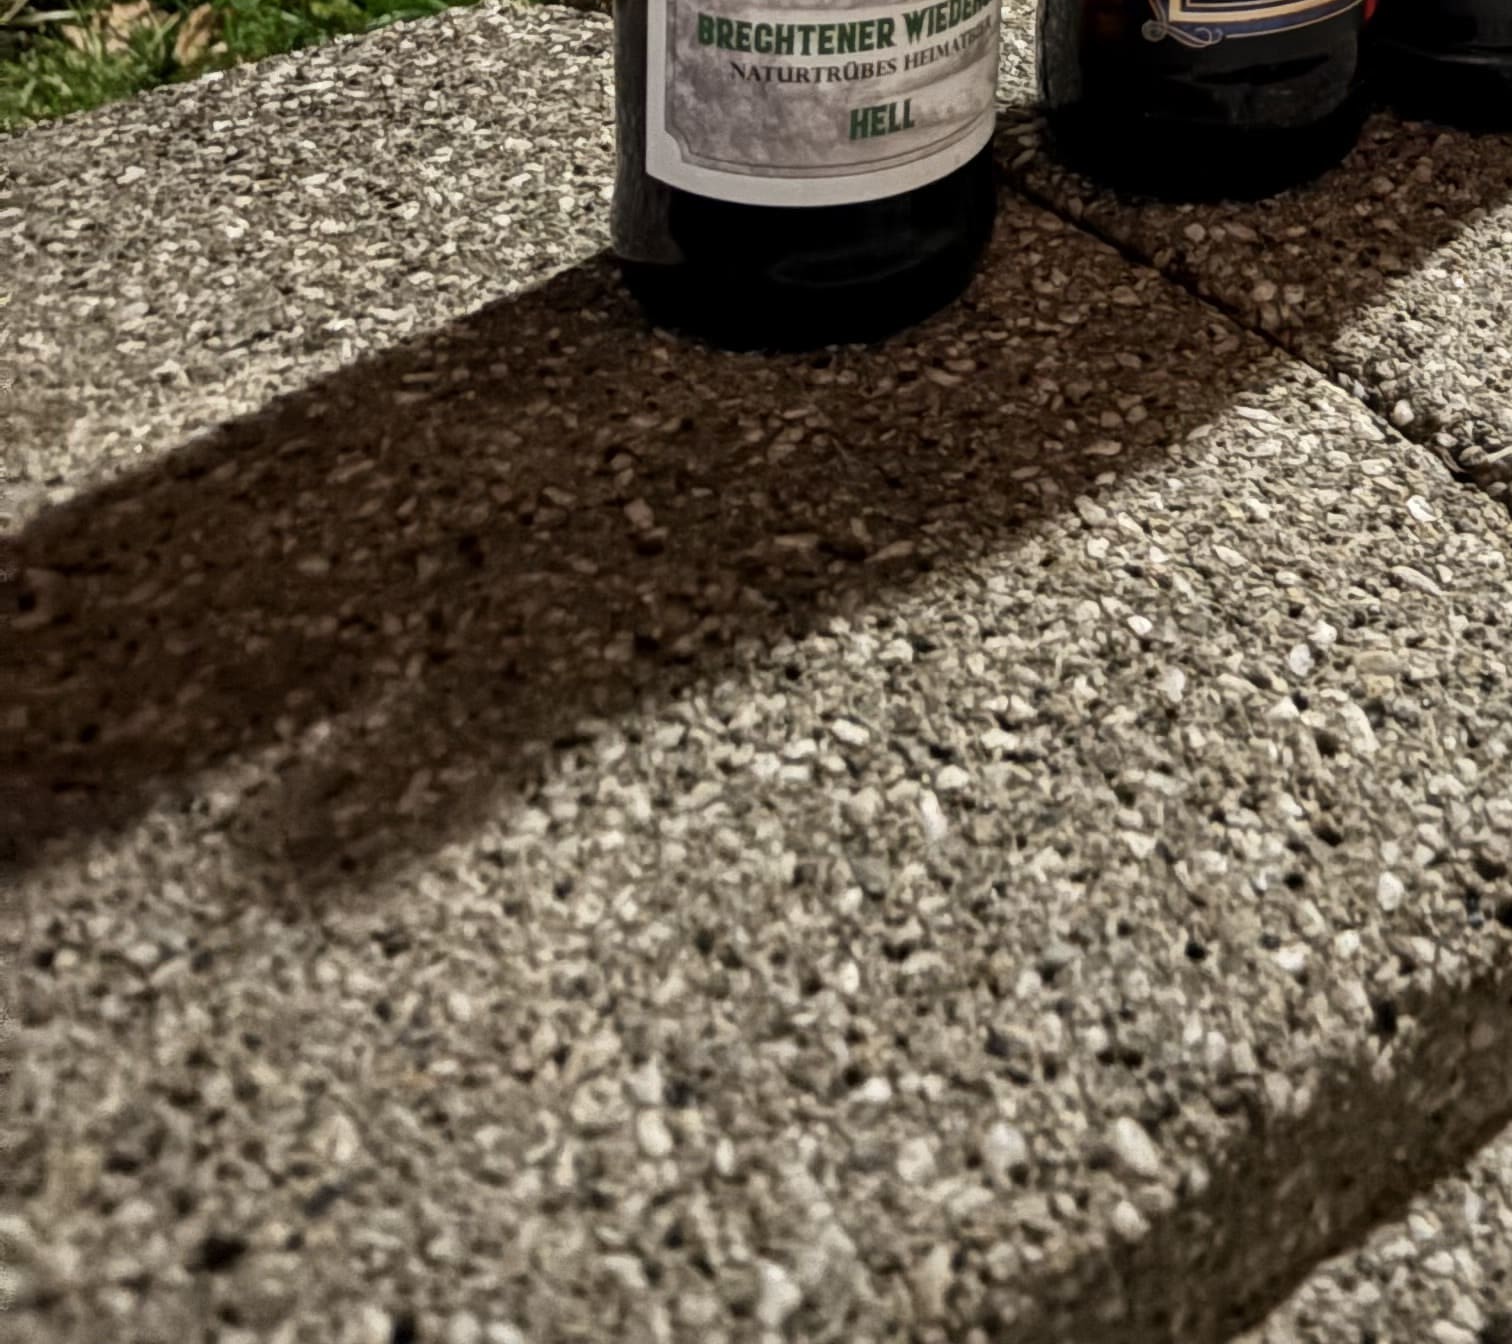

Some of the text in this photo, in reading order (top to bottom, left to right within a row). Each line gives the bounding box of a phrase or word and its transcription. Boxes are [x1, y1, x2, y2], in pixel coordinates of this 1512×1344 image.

[697, 11, 897, 57] BRECHTENER
[730, 56, 898, 84] NATURTRÜBES
[849, 98, 916, 142] HELL
